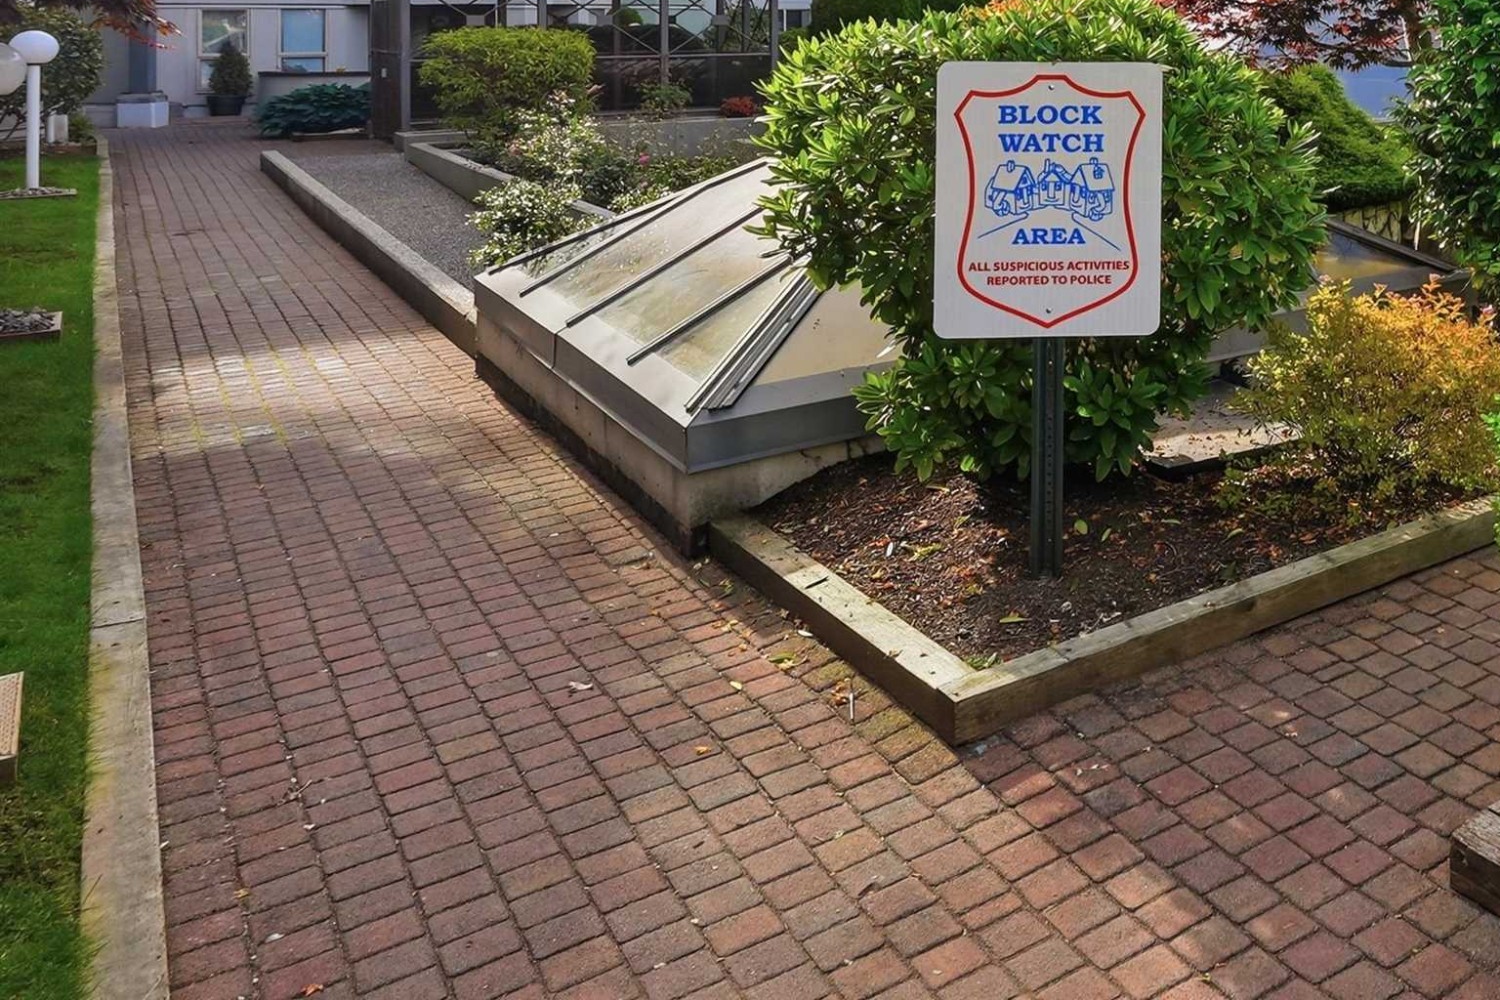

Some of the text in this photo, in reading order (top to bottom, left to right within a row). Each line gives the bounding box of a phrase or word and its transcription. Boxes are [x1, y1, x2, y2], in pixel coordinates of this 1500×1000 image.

[998, 105, 1102, 125] BLOCK
[998, 133, 1104, 153] WATCH
[1011, 228, 1086, 245] AREA
[968, 260, 1130, 272] ALL SUSPICIOUS ACTIVITIES
[986, 275, 1112, 286] REPORTED TO POLICE
